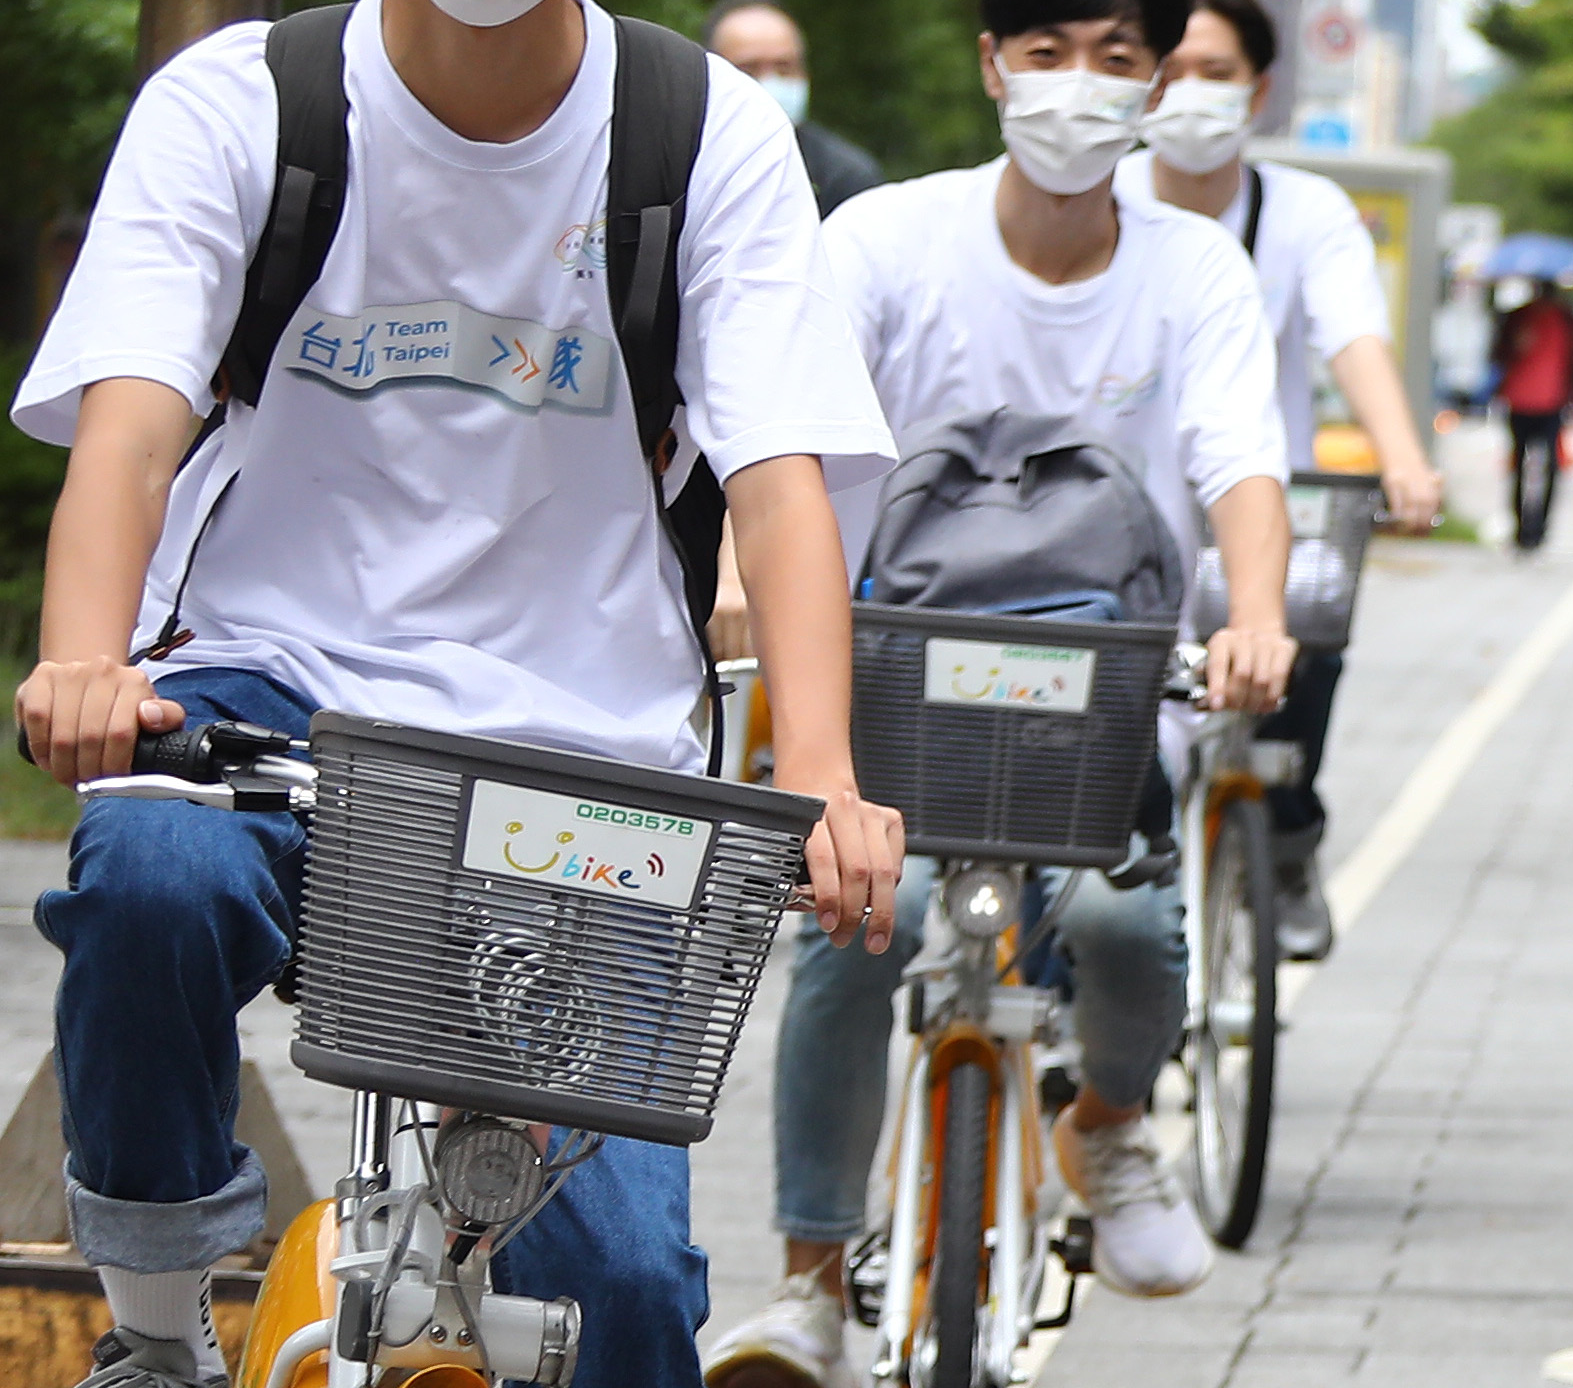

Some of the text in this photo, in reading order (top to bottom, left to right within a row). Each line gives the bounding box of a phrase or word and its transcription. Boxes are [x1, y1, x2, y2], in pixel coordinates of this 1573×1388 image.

[385, 319, 448, 338] Team
[382, 341, 451, 364] Taipei
[576, 802, 696, 836] 0203578
